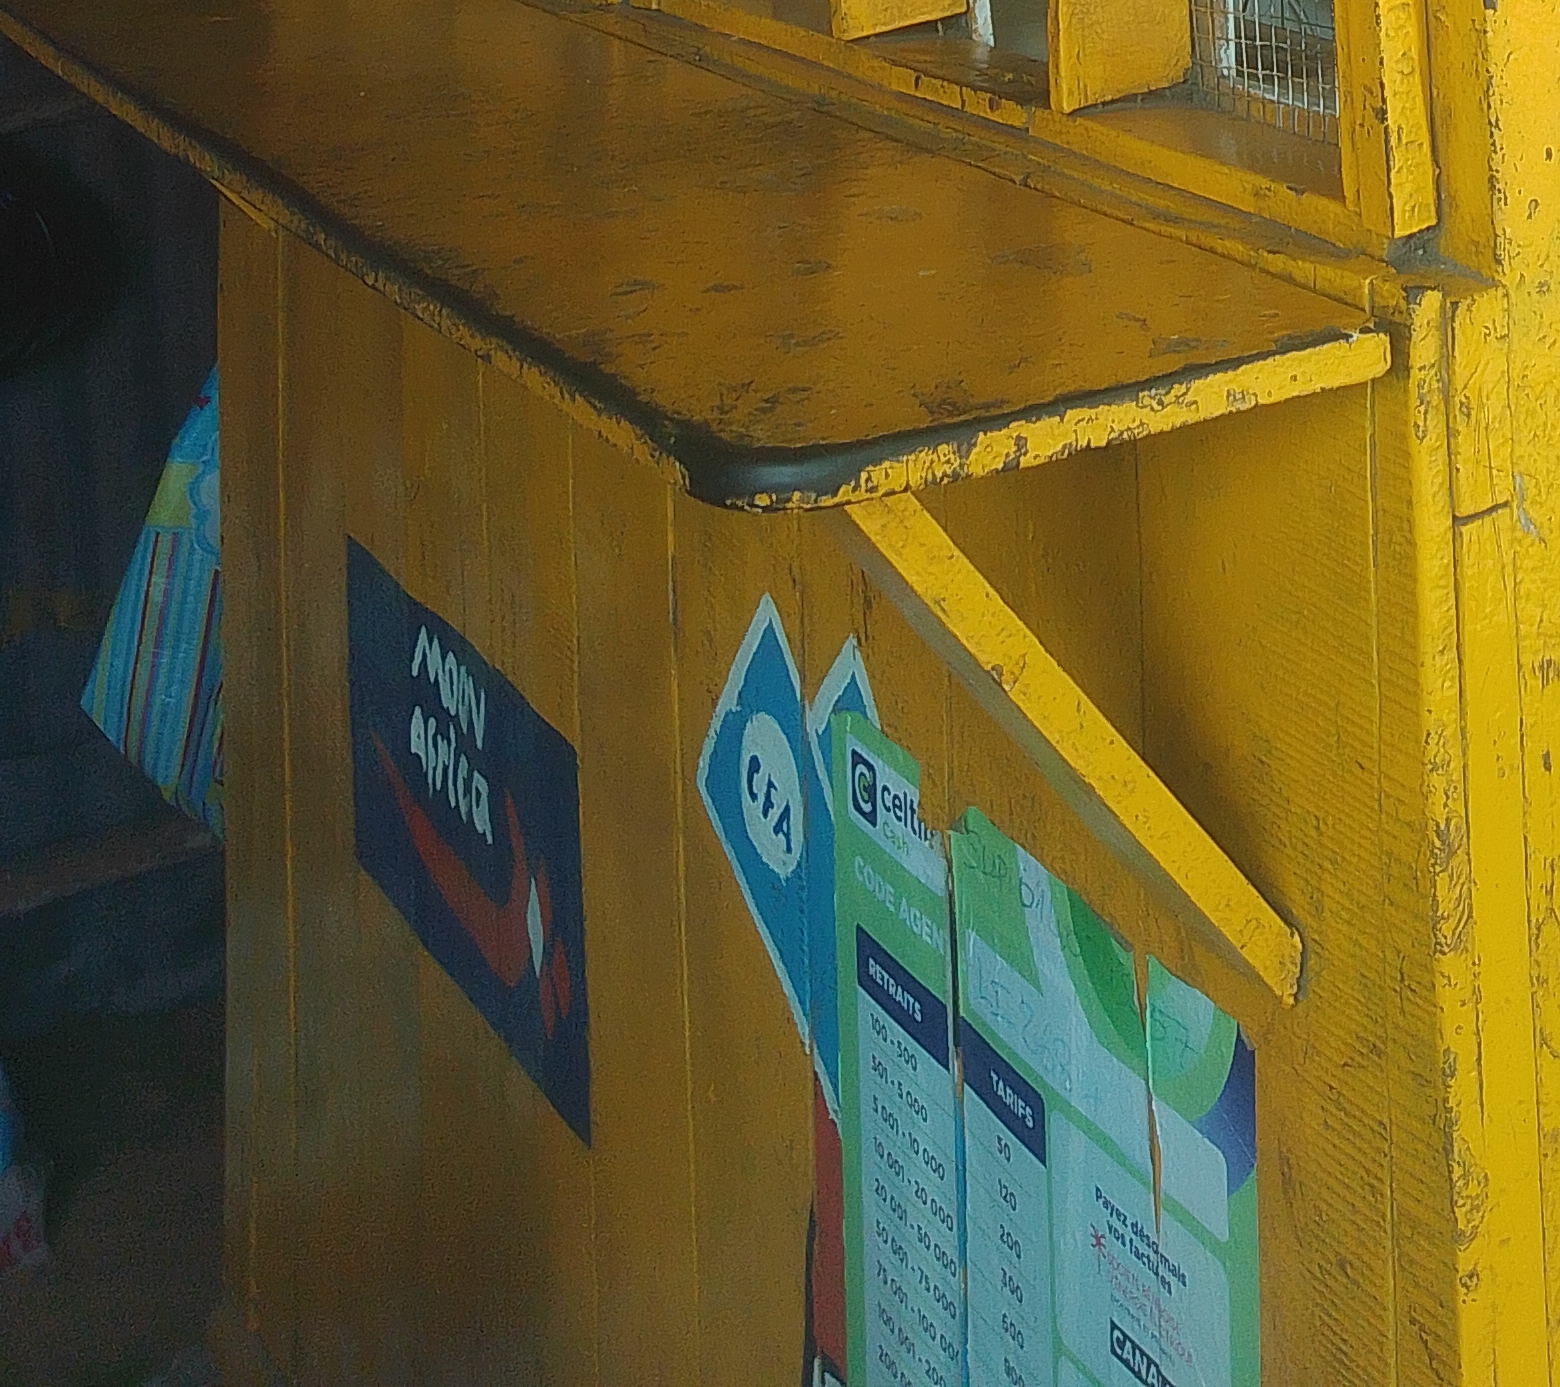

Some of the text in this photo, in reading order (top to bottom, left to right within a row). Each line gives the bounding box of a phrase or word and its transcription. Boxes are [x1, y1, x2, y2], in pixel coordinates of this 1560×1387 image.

[855, 855, 945, 955] CODE AGEN
[868, 957, 923, 1023] RETRAITS
[896, 1040, 918, 1072] 500
[990, 1068, 1035, 1129] TARIFS
[996, 1135, 1012, 1164] 50
[1000, 1223, 1022, 1261] 200
[1106, 1219, 1174, 1298] vos factues
